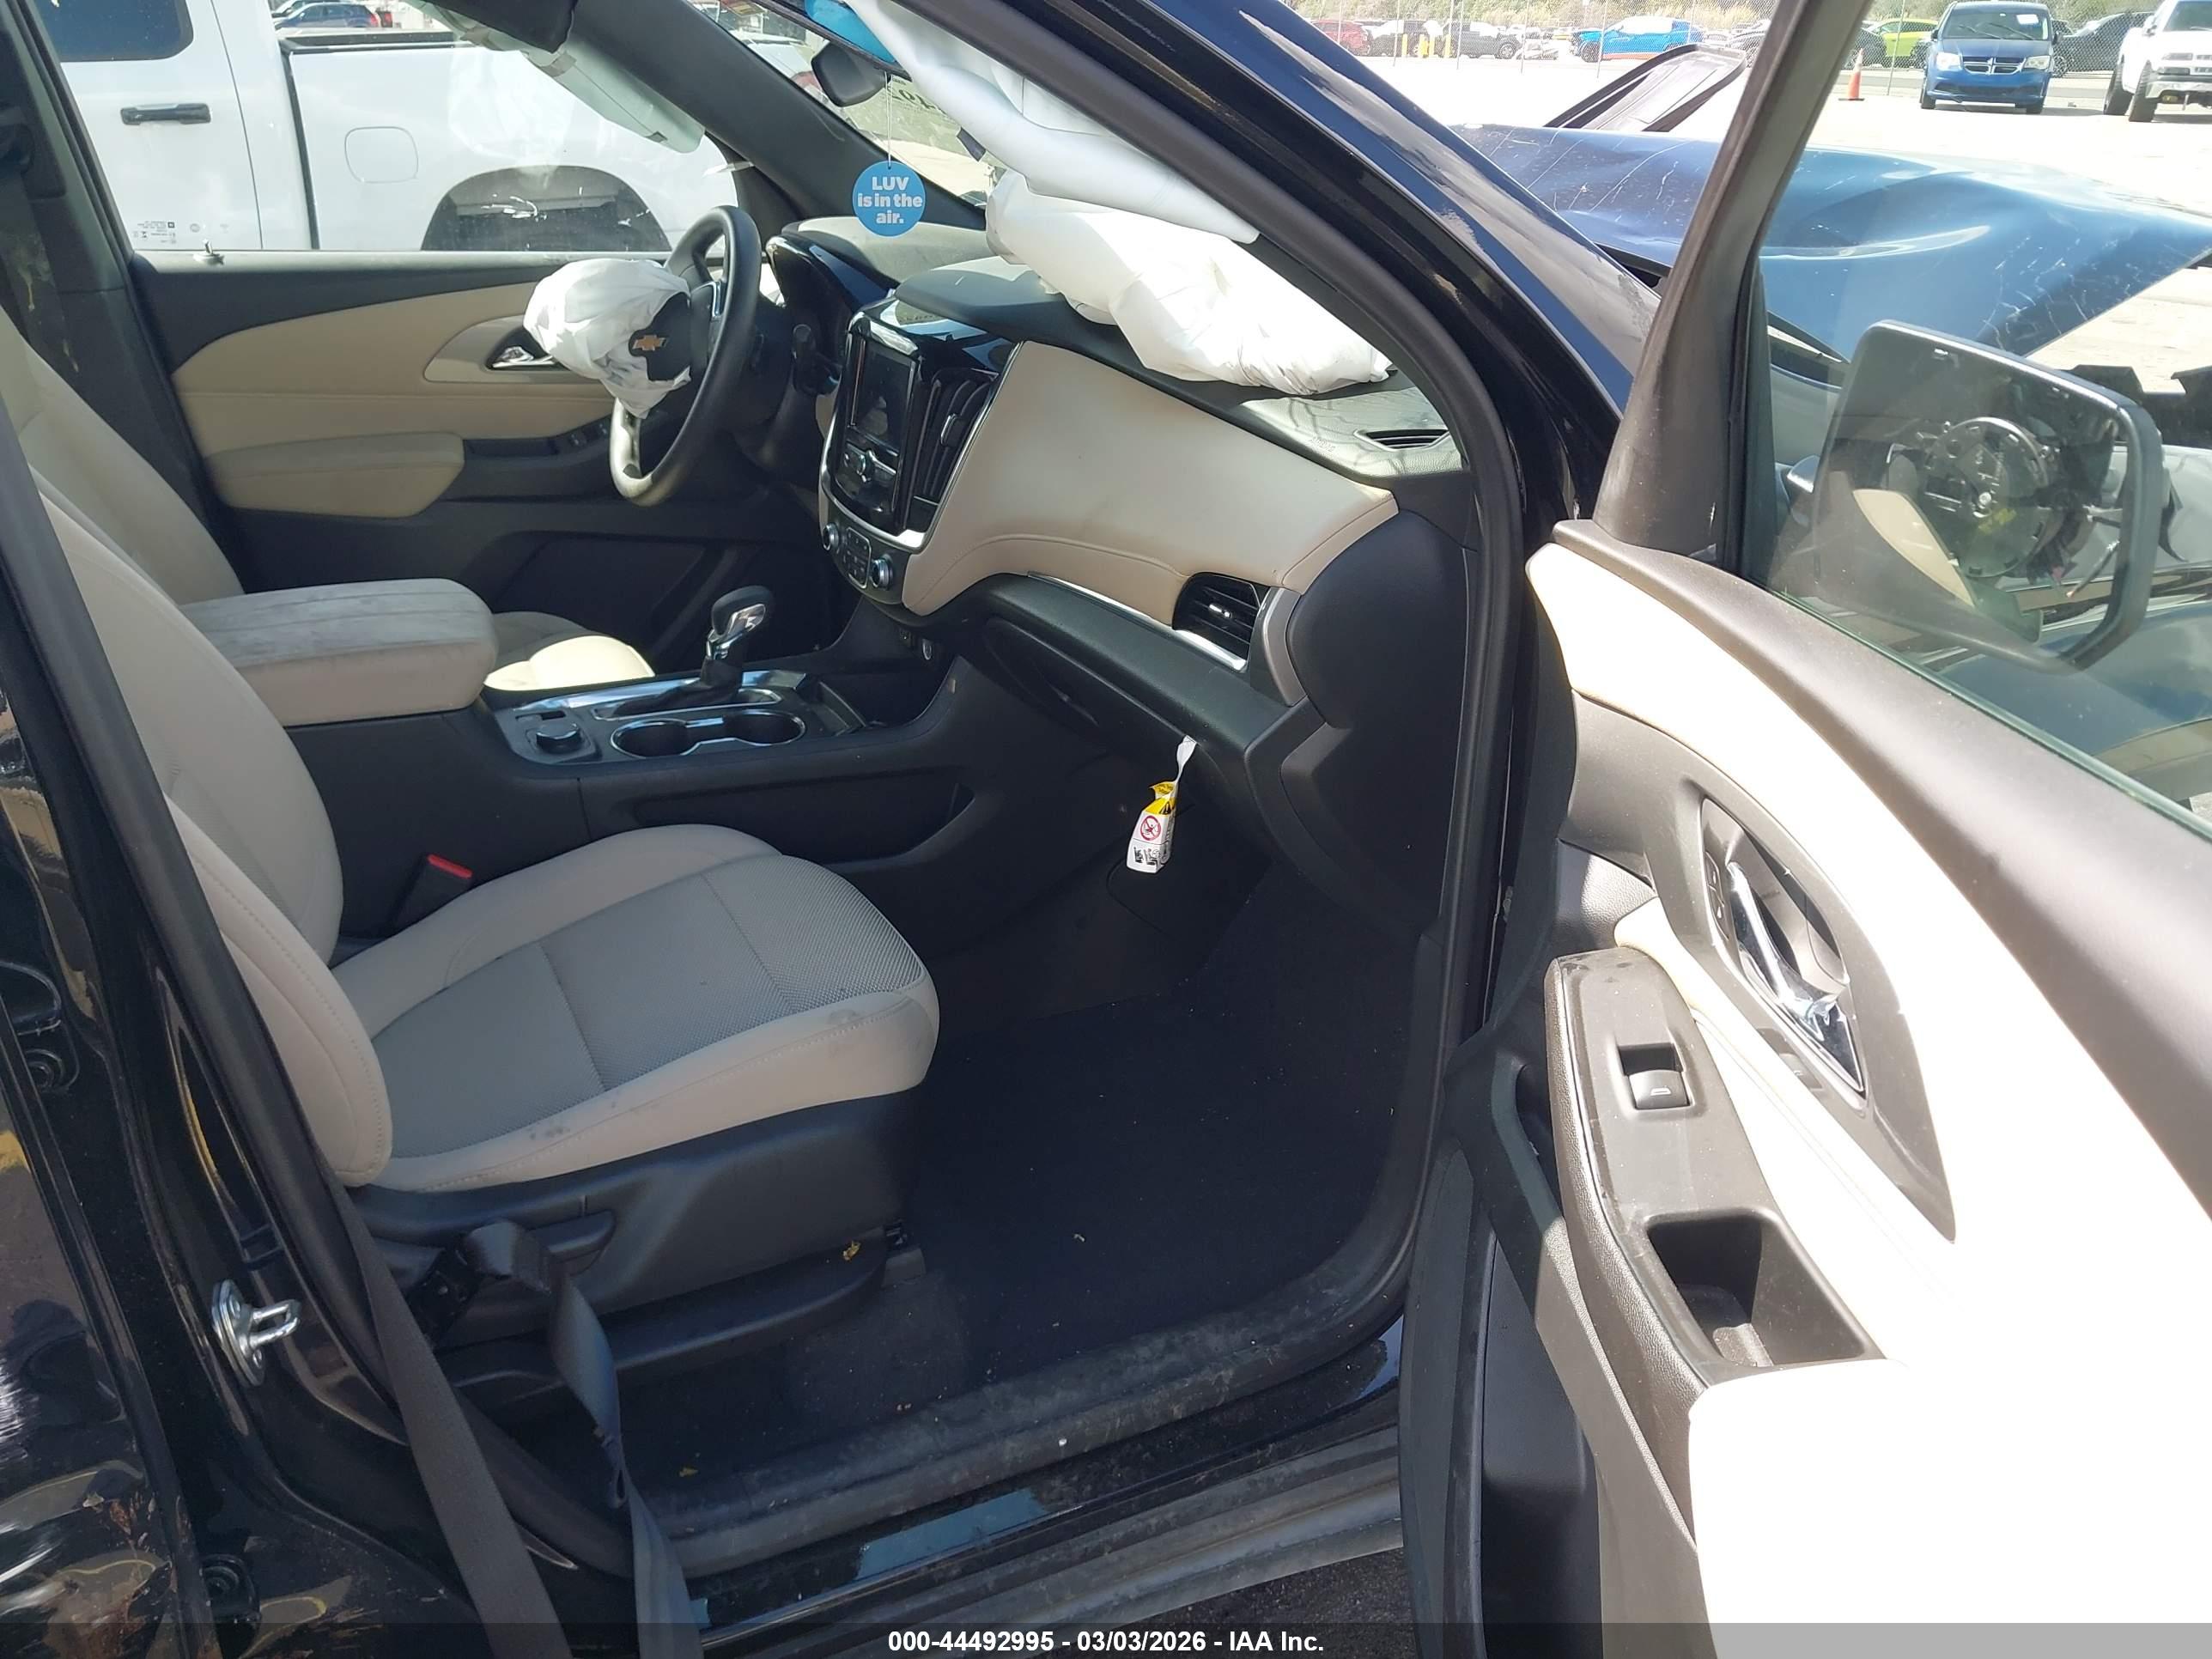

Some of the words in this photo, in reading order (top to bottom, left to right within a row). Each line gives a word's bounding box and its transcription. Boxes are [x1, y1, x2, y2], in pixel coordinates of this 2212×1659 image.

[872, 176, 909, 191] LUV
[858, 192, 872, 207] is
[874, 192, 891, 207] in
[893, 192, 923, 208] the
[876, 210, 904, 224] air.
